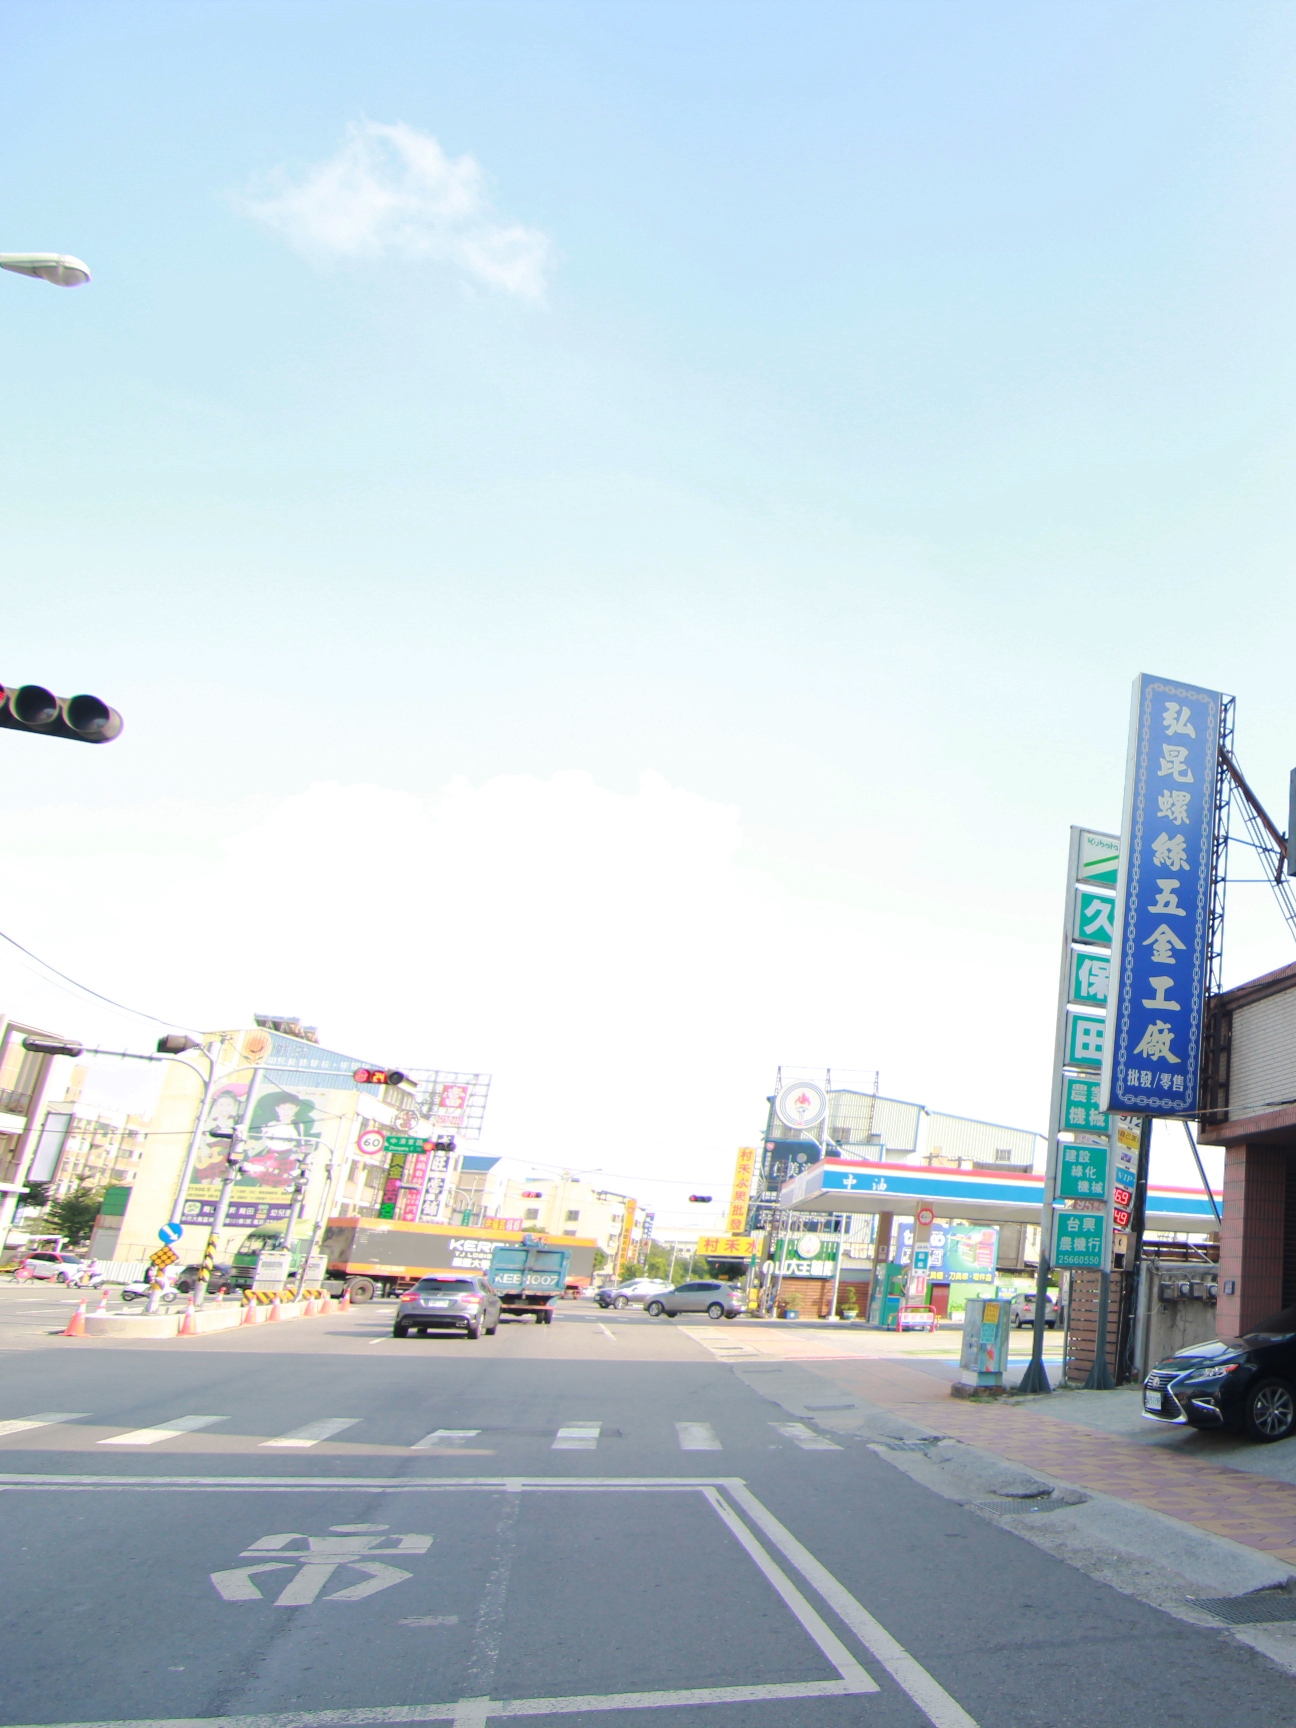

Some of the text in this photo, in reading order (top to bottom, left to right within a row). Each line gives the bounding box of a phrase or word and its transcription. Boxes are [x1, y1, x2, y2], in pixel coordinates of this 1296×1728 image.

[1133, 701, 1196, 1064] 弘昆螺絲五金工廠
[373, 1072, 386, 1083] 24
[1127, 1068, 1185, 1093] 批發/零售
[1069, 1106, 1105, 1127] 機械
[363, 1138, 380, 1148] 60
[1065, 1149, 1091, 1163] 建設
[1071, 1165, 1097, 1179] 綠化
[843, 1174, 887, 1191] 中油
[1077, 1180, 1104, 1194] 機械
[729, 1150, 752, 1231] 村禾水果批發
[1067, 1217, 1096, 1232] 台興
[1058, 1236, 1101, 1252] 農機行
[1058, 1255, 1099, 1265] 25660550
